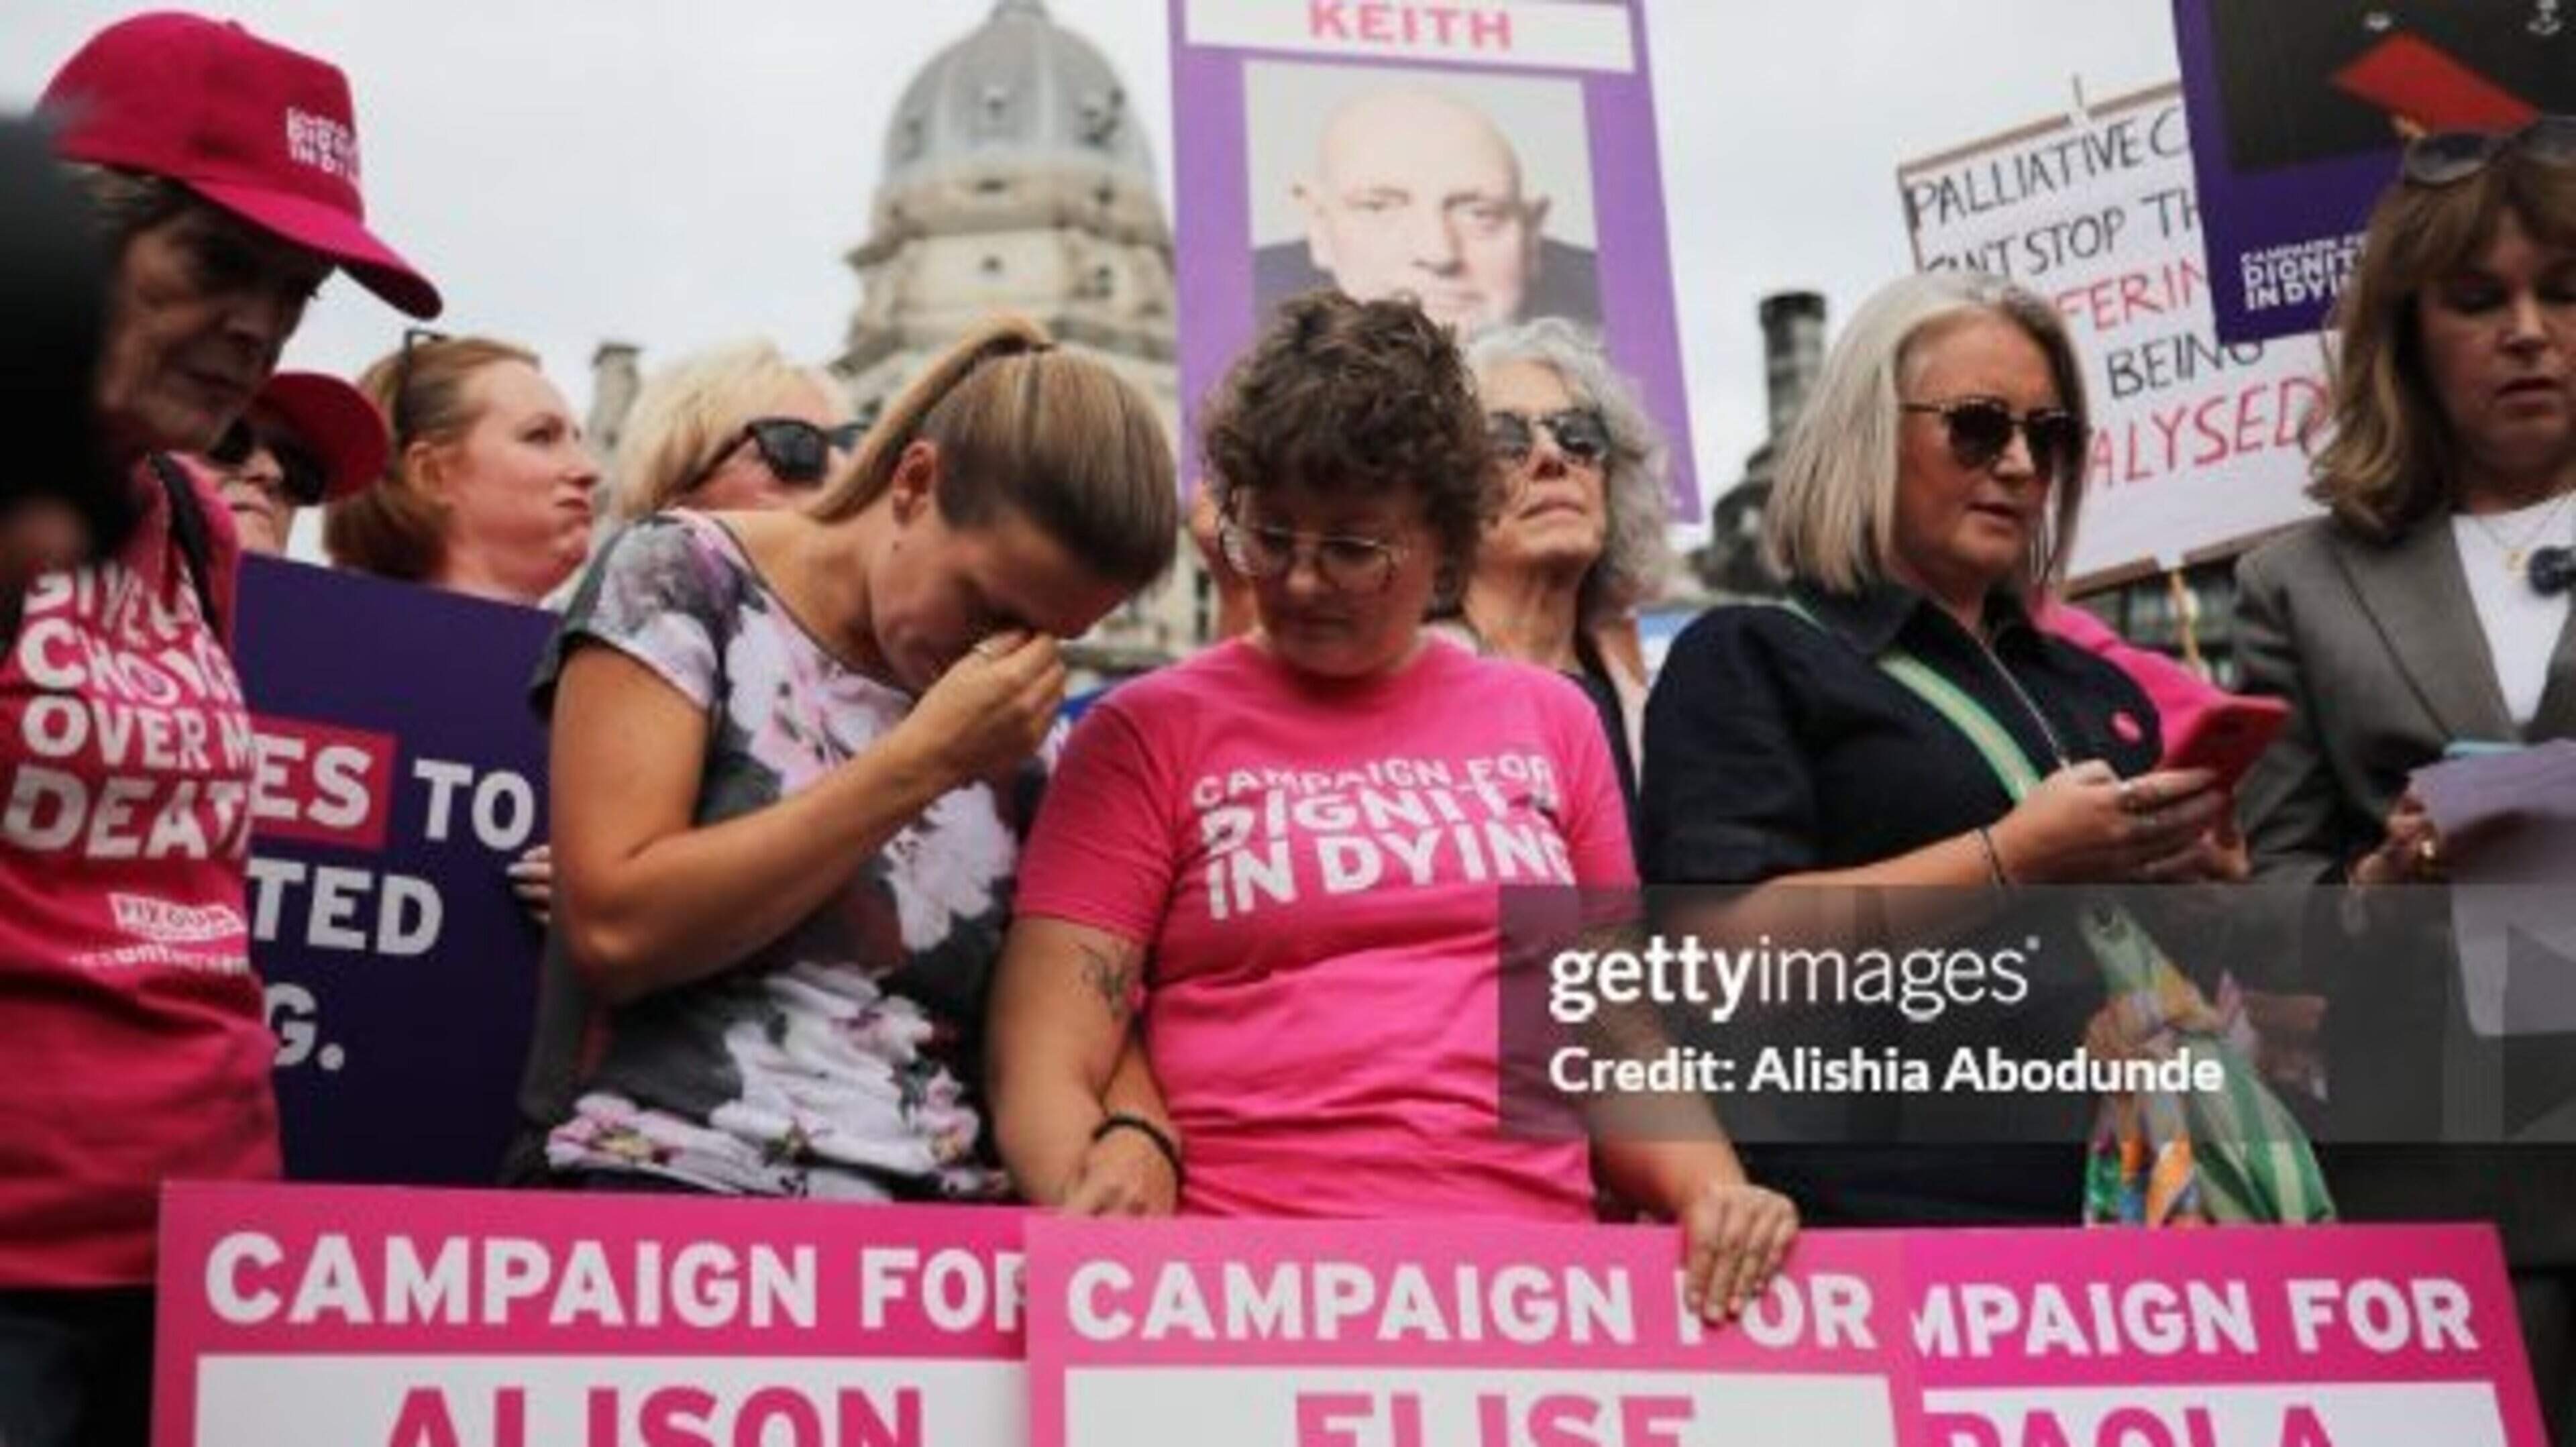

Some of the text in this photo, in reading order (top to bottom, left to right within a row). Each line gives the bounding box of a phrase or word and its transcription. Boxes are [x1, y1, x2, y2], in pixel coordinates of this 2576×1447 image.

[1309, 0, 1511, 50] KEITH
[1907, 118, 2143, 227] PALLIATIVE
[2025, 207, 2127, 276] STOP
[2244, 248, 2359, 288] DIGNIT
[2246, 274, 2341, 310] IN DYI
[22, 694, 211, 770] OVER
[413, 757, 535, 851] TO
[1191, 758, 1452, 808] CAMPAIGN
[1201, 782, 1536, 857] DIGNIT
[246, 857, 443, 956] TED
[1209, 839, 1298, 920] IN
[203, 1232, 818, 1328] CAMPAIGN
[1067, 1260, 1635, 1346] CAMPAIGN
[2287, 1277, 2480, 1355] FOR
